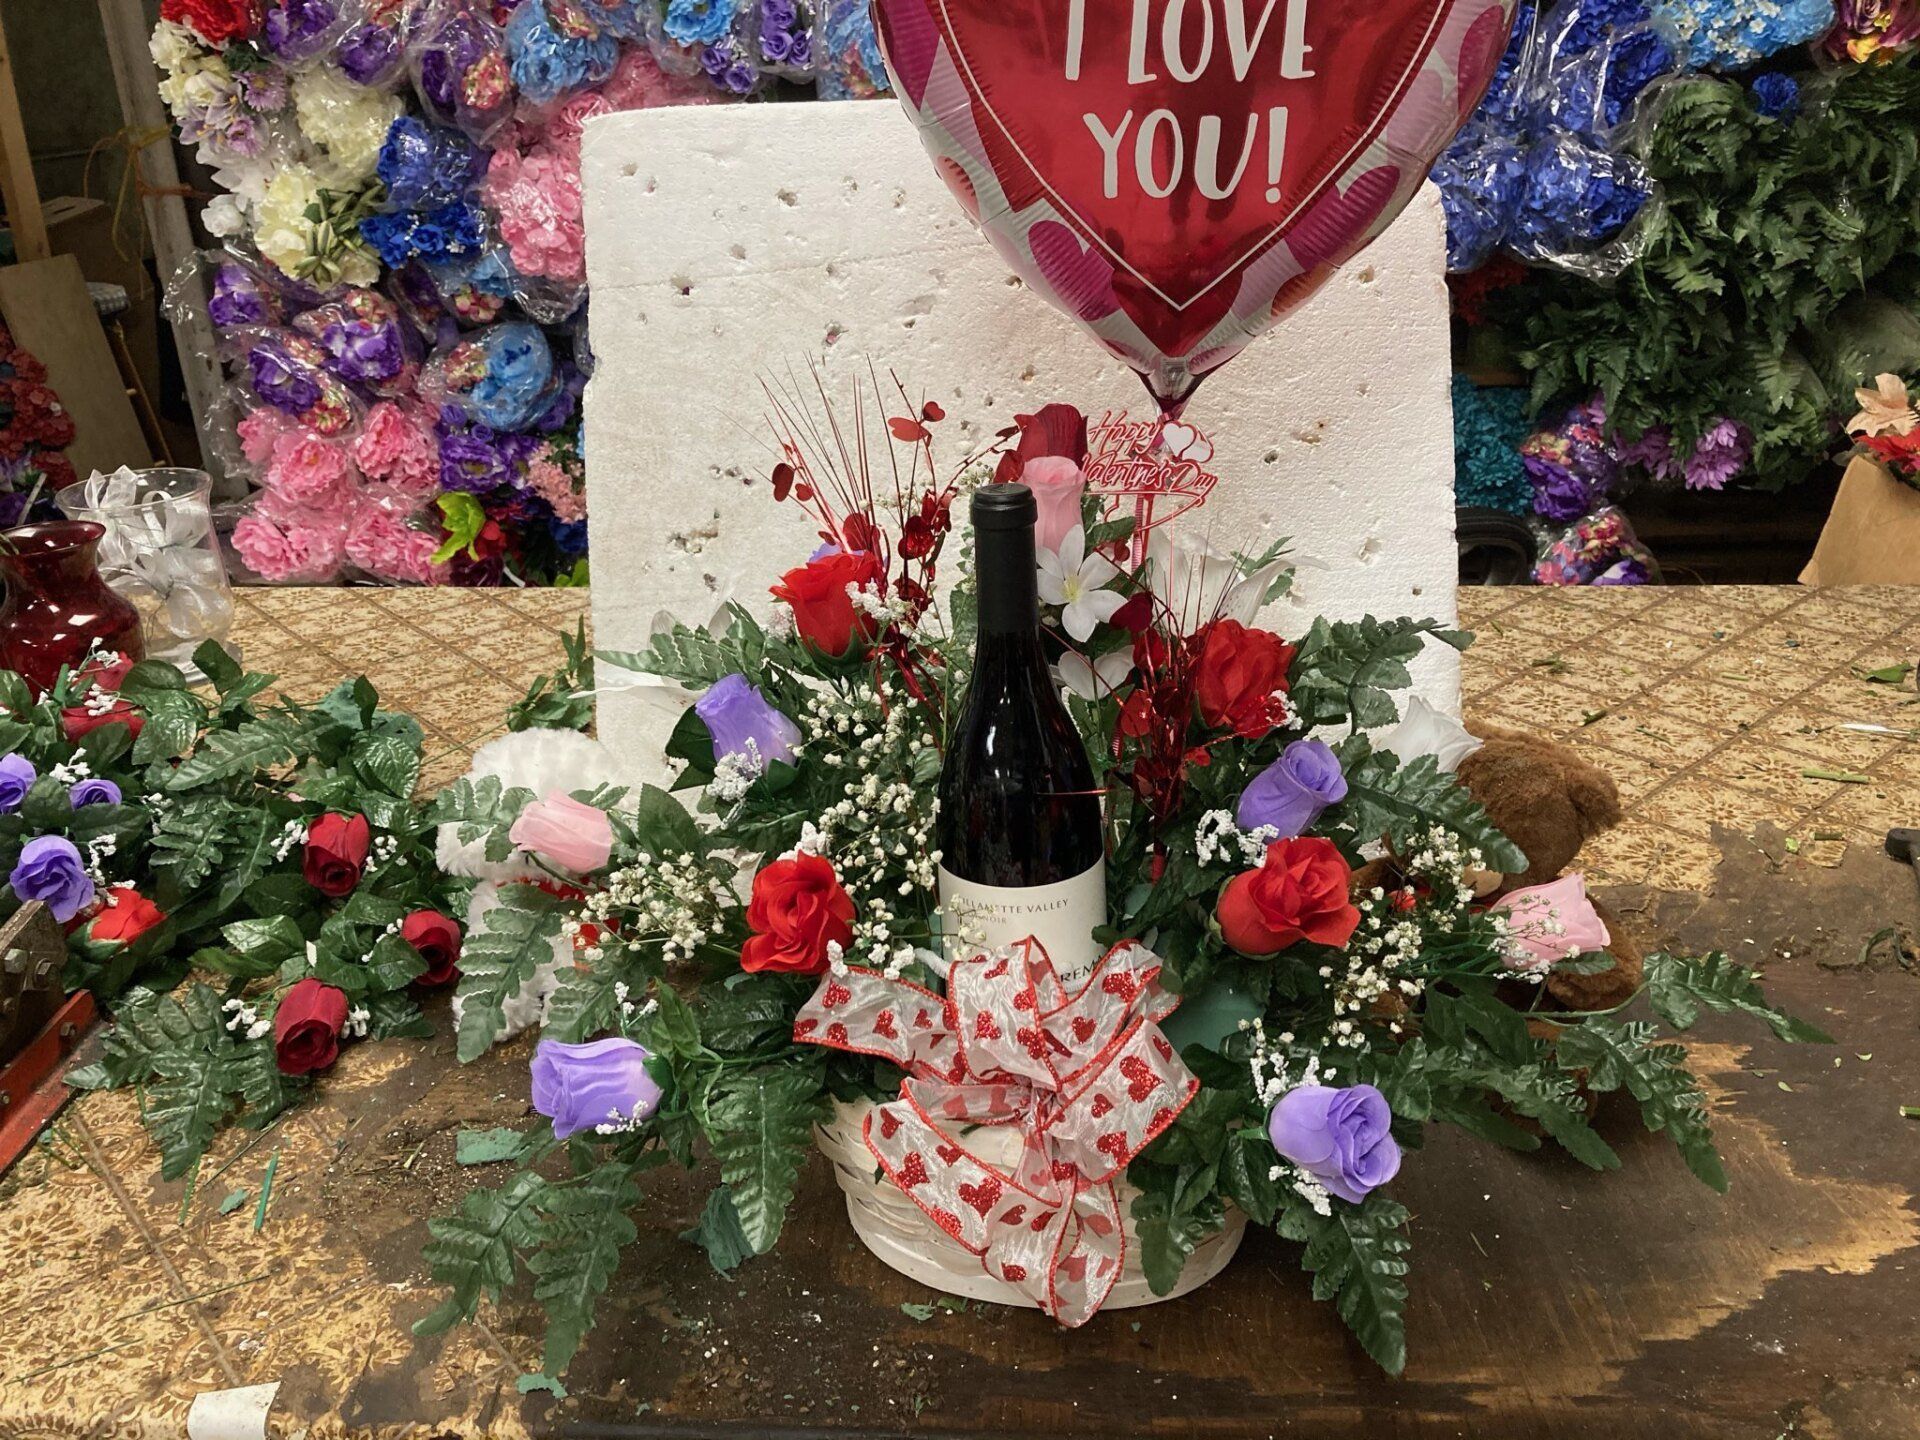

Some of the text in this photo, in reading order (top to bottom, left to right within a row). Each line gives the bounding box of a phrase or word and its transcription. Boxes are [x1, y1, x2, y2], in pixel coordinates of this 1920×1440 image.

[1065, 0, 1315, 84] I LOVE
[1083, 106, 1289, 204] YOU!
[1089, 410, 1161, 454] Happy
[1081, 451, 1218, 503] Valentine's Day
[956, 896, 1069, 914] ILLAMTTE VALLEY
